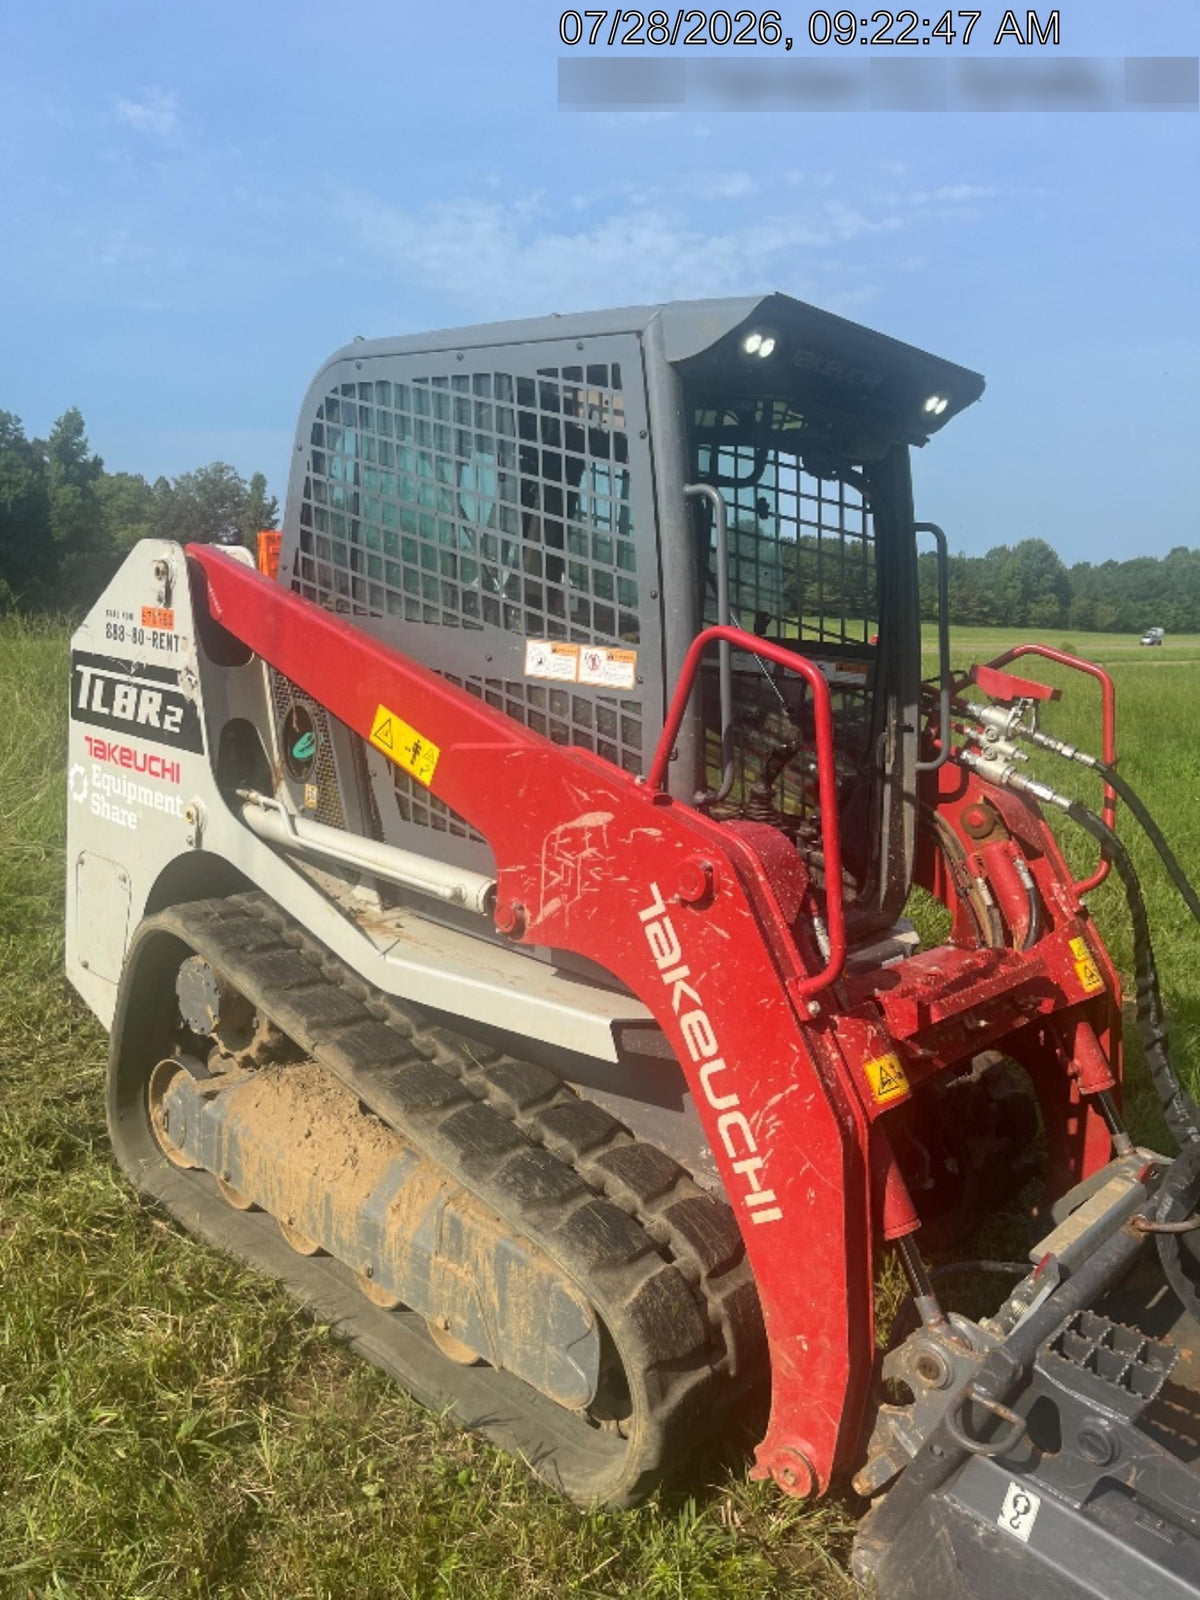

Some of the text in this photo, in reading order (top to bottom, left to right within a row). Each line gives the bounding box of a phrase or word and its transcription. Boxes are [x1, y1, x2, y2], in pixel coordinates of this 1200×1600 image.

[90, 791, 138, 829] Share
[91, 763, 184, 818] Equipment
[638, 881, 784, 1225] TAKEUCHI
